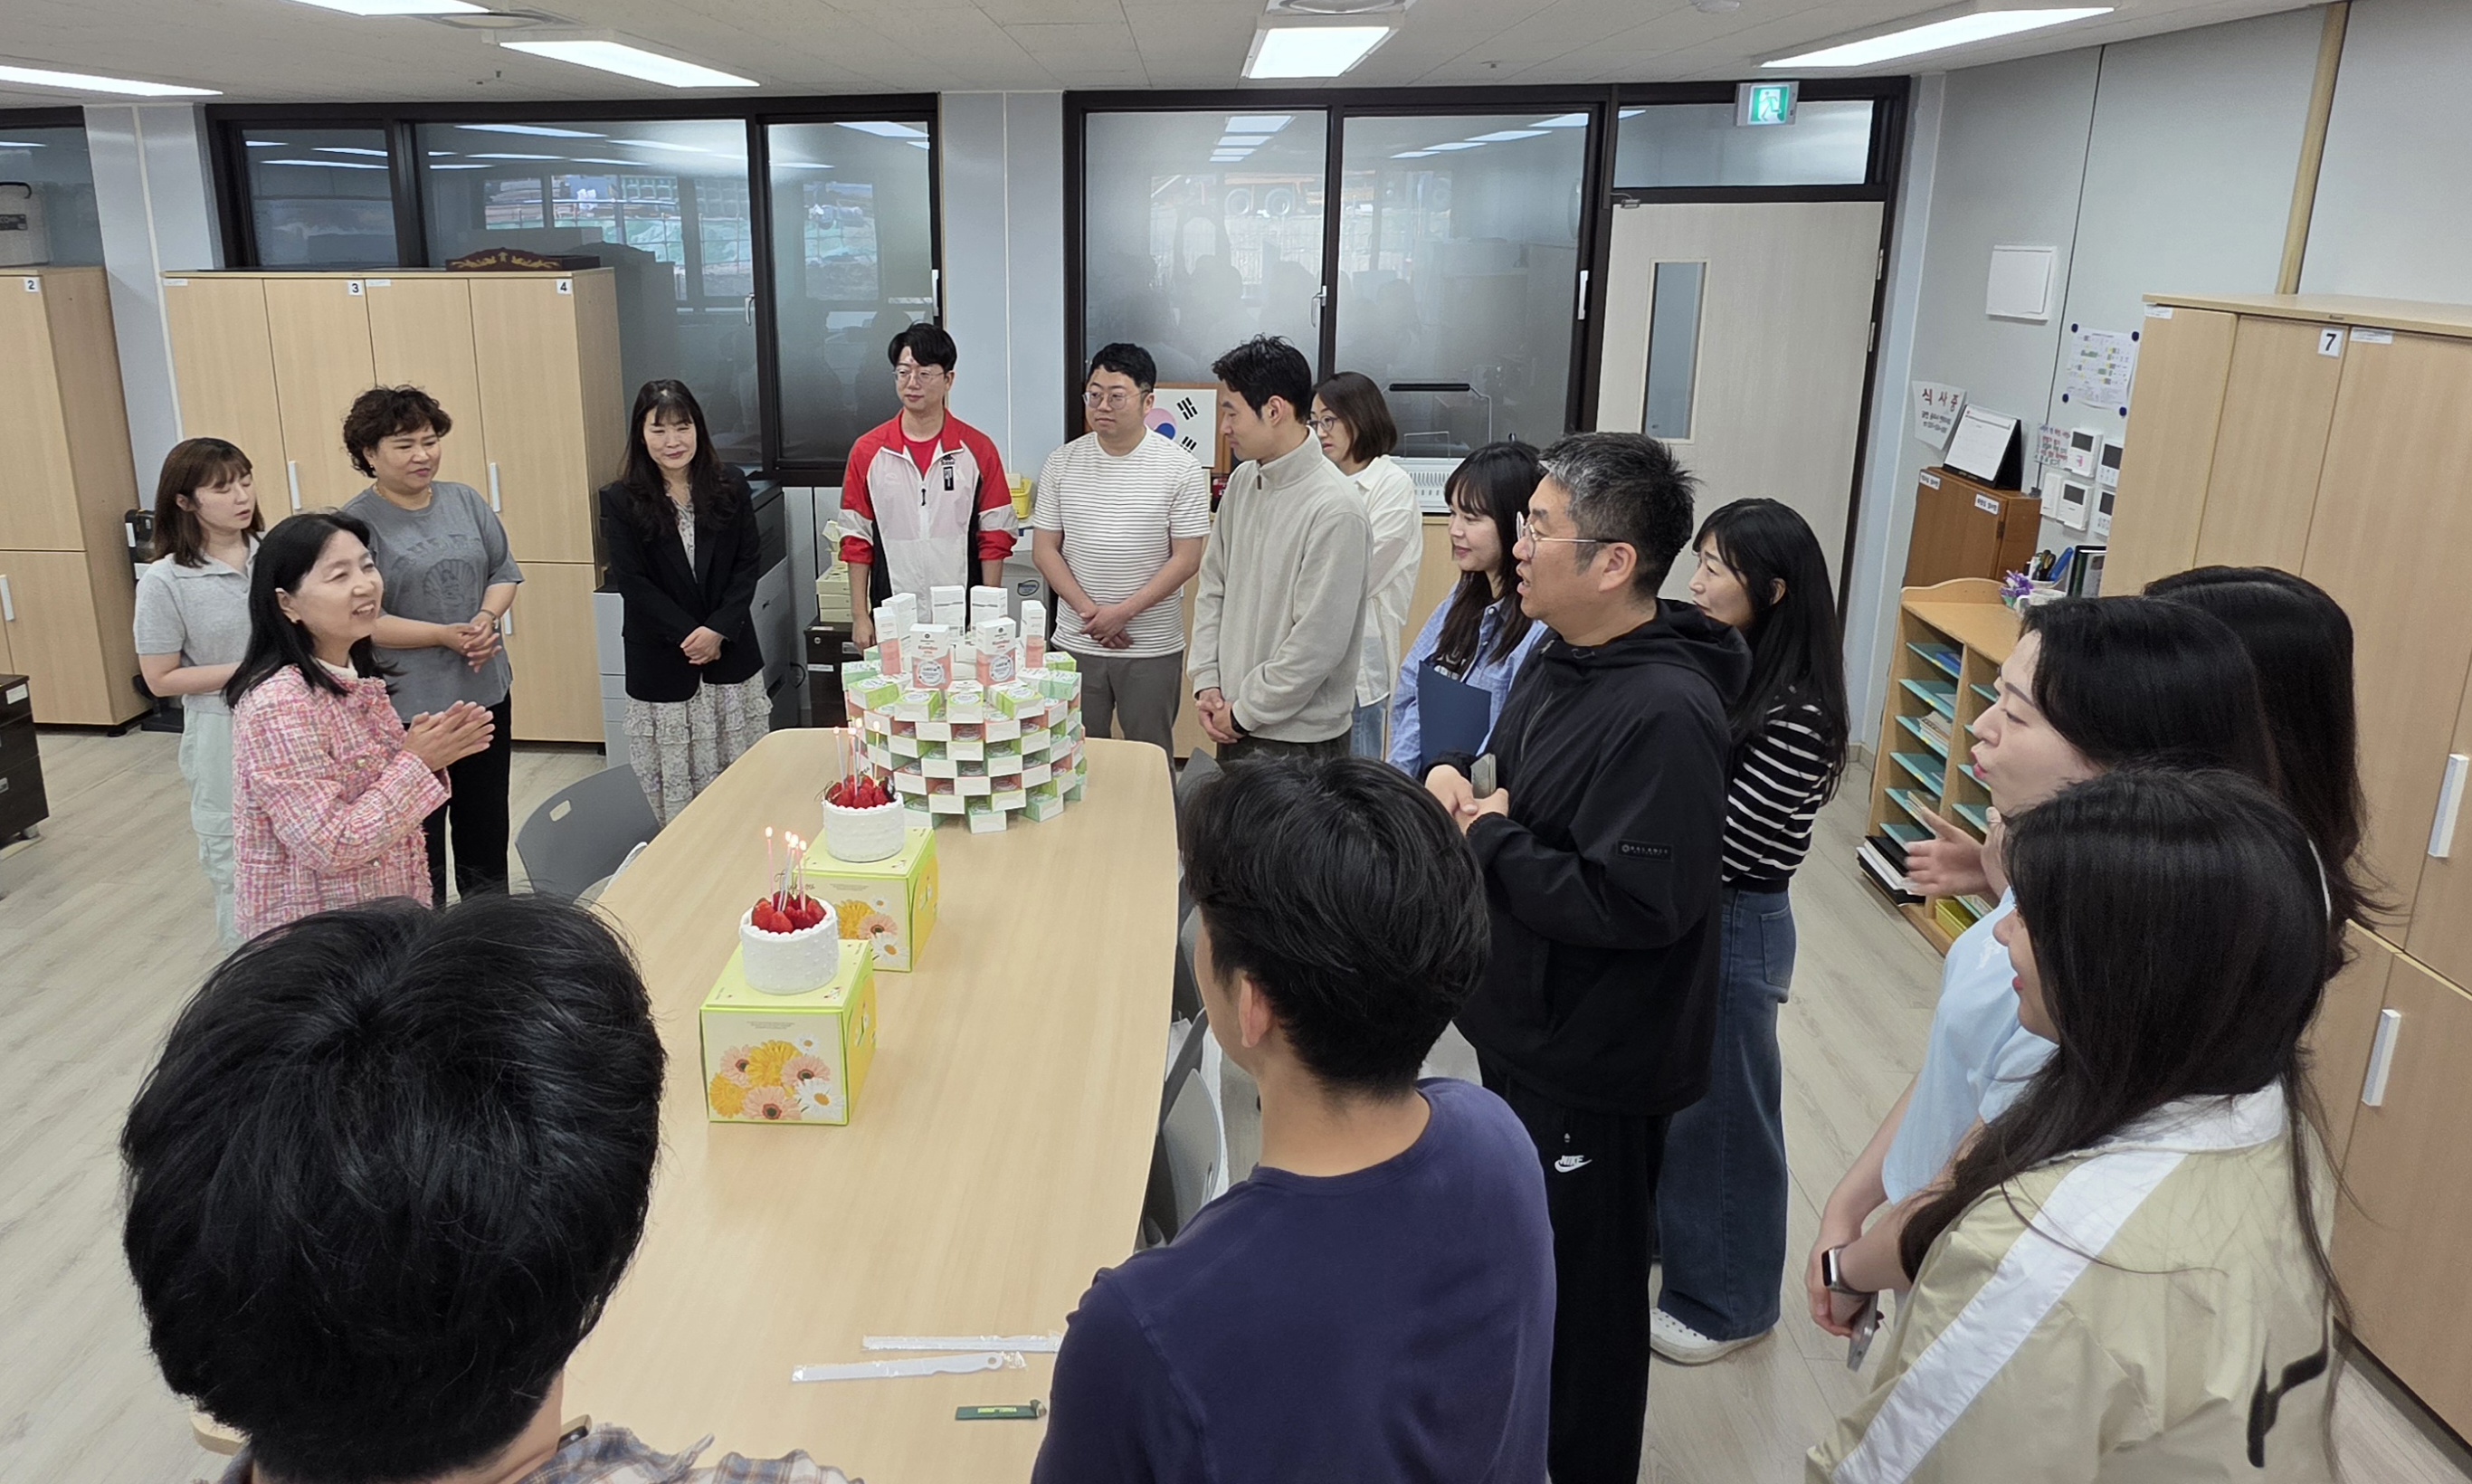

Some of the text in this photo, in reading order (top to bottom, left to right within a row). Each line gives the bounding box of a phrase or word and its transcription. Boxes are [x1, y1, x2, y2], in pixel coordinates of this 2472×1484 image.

[27, 280, 35, 290] 2
[351, 282, 359, 293] 3
[559, 281, 567, 292] 4
[2325, 332, 2337, 351] 7
[1559, 1155, 1584, 1165] NIKE
